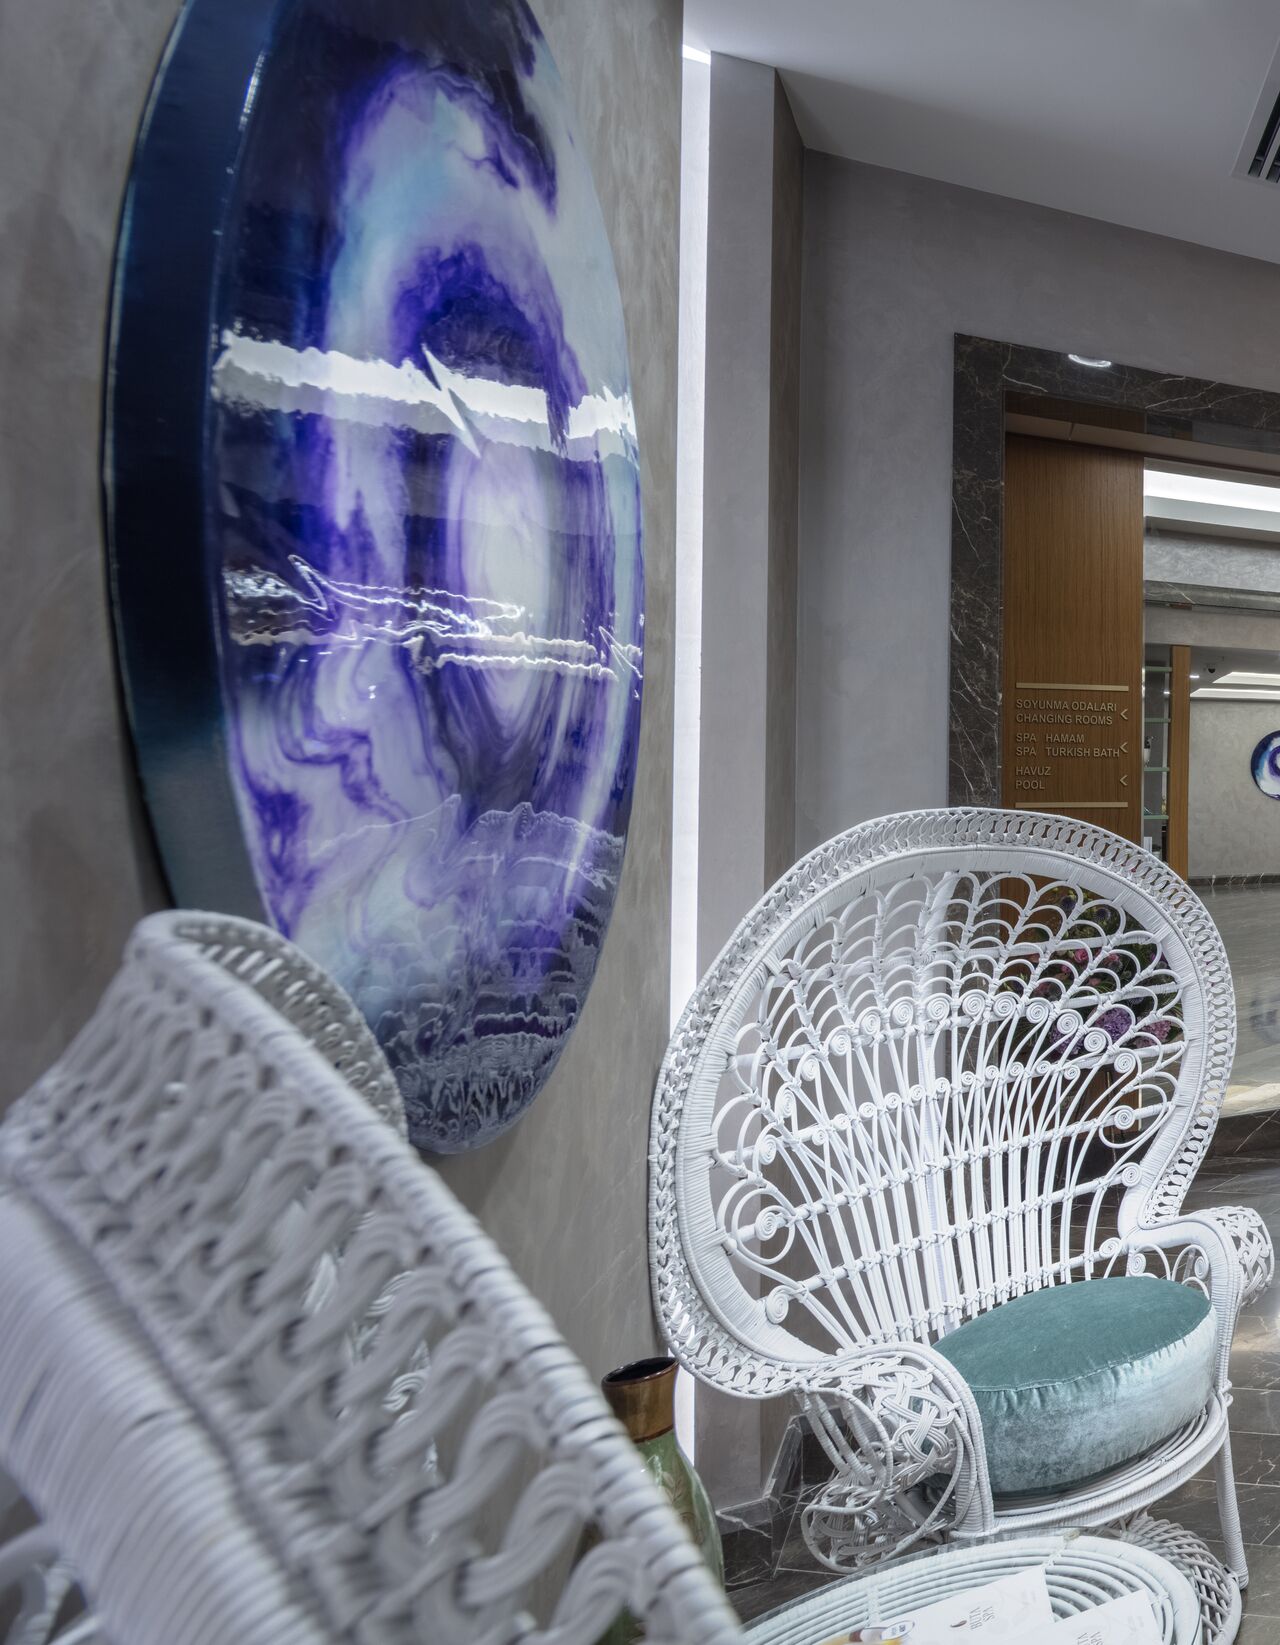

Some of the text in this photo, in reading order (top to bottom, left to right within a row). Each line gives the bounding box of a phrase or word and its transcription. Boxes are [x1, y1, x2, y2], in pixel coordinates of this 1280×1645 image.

[1016, 699, 1117, 712] SOYUNMA ODALARI
[1016, 713, 1113, 725] CHANGING ROOMS
[1016, 733, 1085, 743] SPA HAMAM
[1016, 746, 1120, 758] SPA TURKISH BATH
[1015, 766, 1052, 776] HAVUZ
[1015, 780, 1045, 790] POOL
[969, 1606, 982, 1630] BUTA
[982, 1606, 996, 1622] SPA
